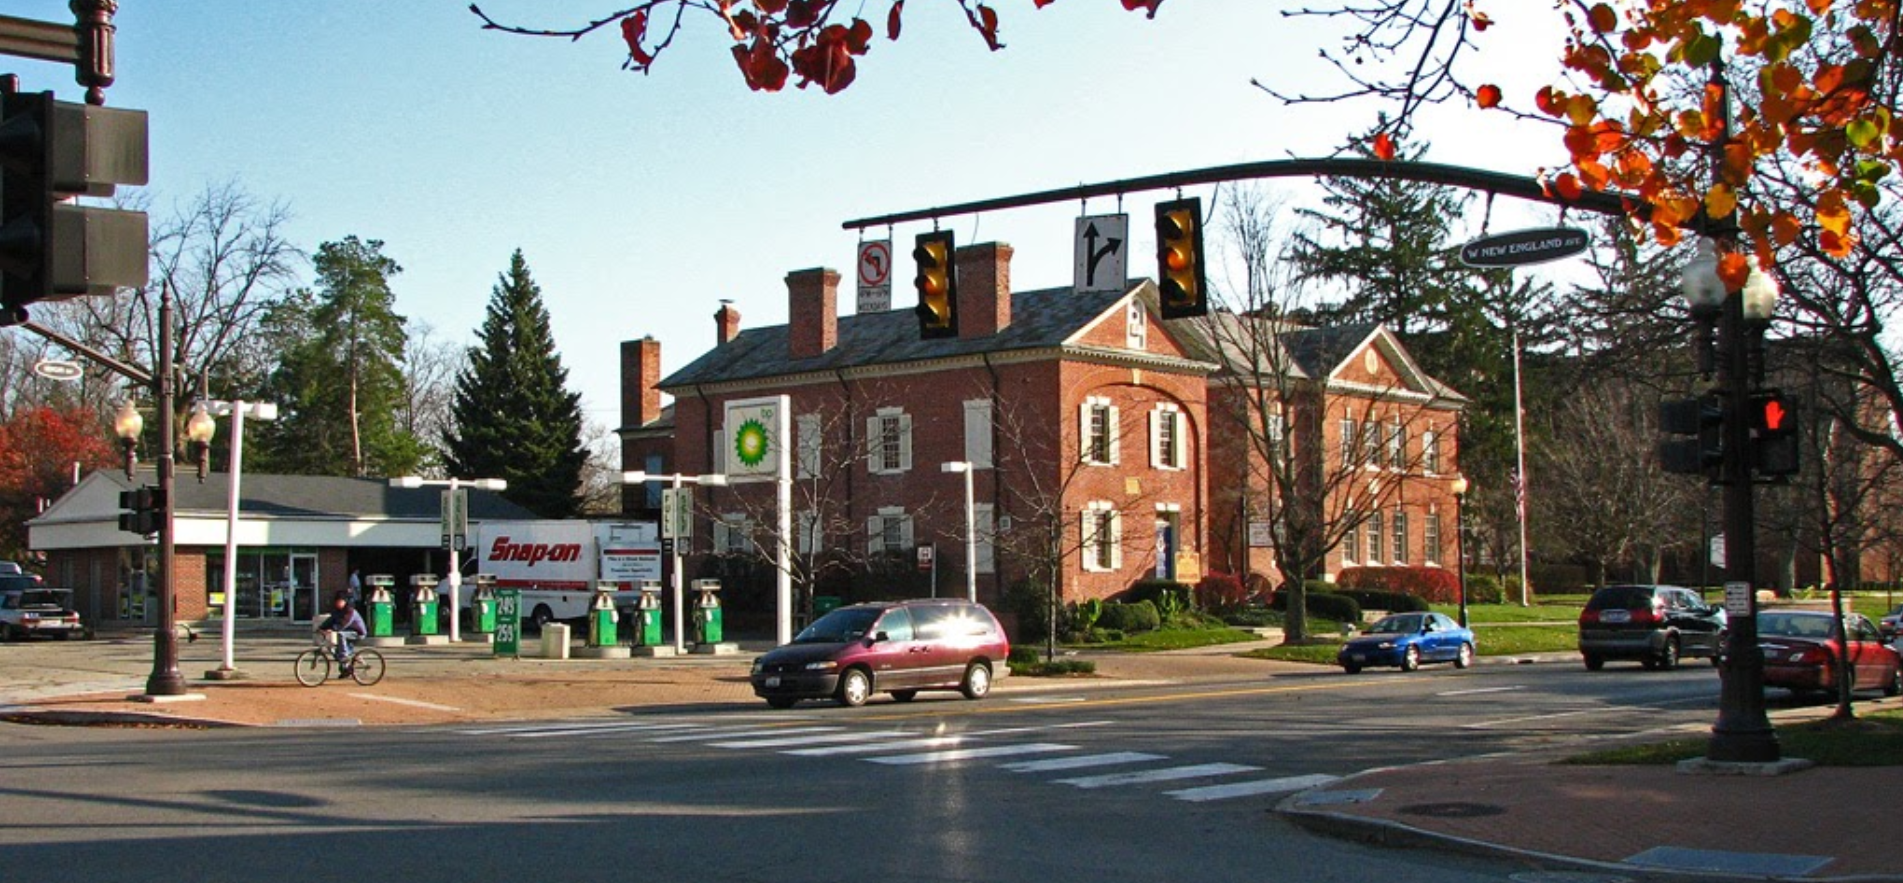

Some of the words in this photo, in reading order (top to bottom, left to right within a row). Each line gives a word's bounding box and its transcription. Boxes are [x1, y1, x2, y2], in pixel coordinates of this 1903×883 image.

[1467, 248, 1480, 259] W
[1481, 245, 1508, 257] NEW
[1508, 239, 1562, 254] ENGLAND
[761, 408, 774, 420] bp
[488, 536, 582, 567] Snap-on
